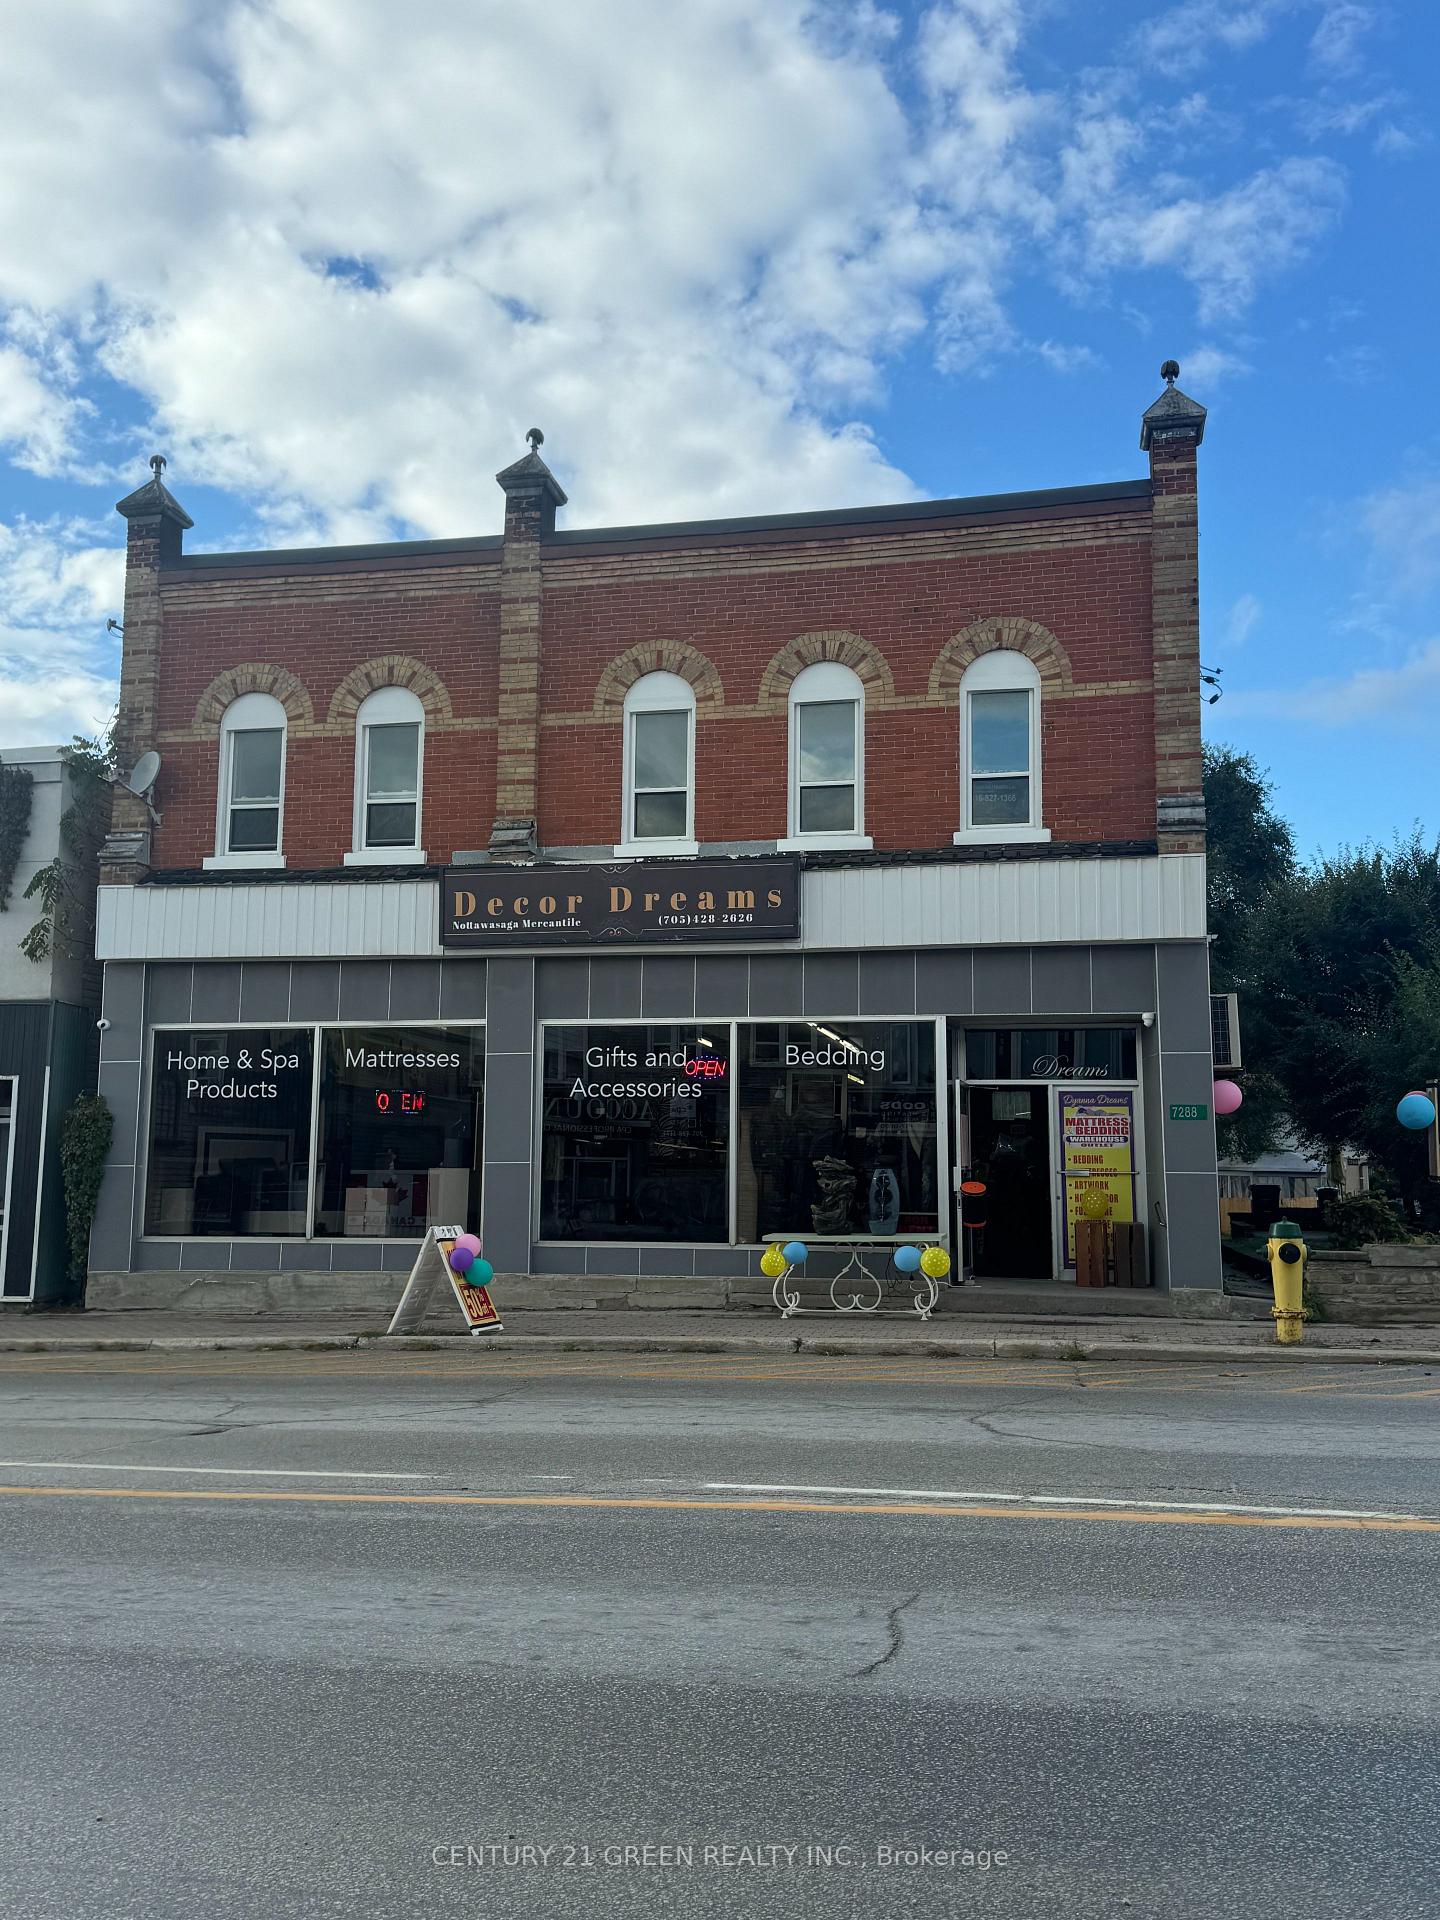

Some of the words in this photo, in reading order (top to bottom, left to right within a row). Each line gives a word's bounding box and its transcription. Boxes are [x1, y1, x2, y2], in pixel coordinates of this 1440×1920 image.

[453, 891, 583, 917] Decor
[609, 886, 782, 912] Dreams
[453, 921, 519, 931] Nottawasaga
[522, 918, 581, 928] Mercantile
[167, 1051, 230, 1070] Home
[237, 1049, 253, 1069] &
[260, 1049, 299, 1076] Spa
[345, 1048, 460, 1068] Mattresses
[586, 1046, 637, 1068] Gifts
[645, 1046, 686, 1067] and
[785, 1044, 885, 1071] Bedding
[1030, 1055, 1109, 1077] Dreams
[685, 1060, 726, 1076] OPEN
[187, 1078, 278, 1098] Products
[569, 1077, 702, 1097] Accessories
[377, 1093, 423, 1110] OEN
[1097, 1095, 1128, 1104] Dreams
[1171, 1106, 1198, 1118] 7288
[1065, 1118, 1129, 1126] MATTRESS
[1075, 1127, 1129, 1135] BEDDING
[1073, 1155, 1104, 1164] BEDDING
